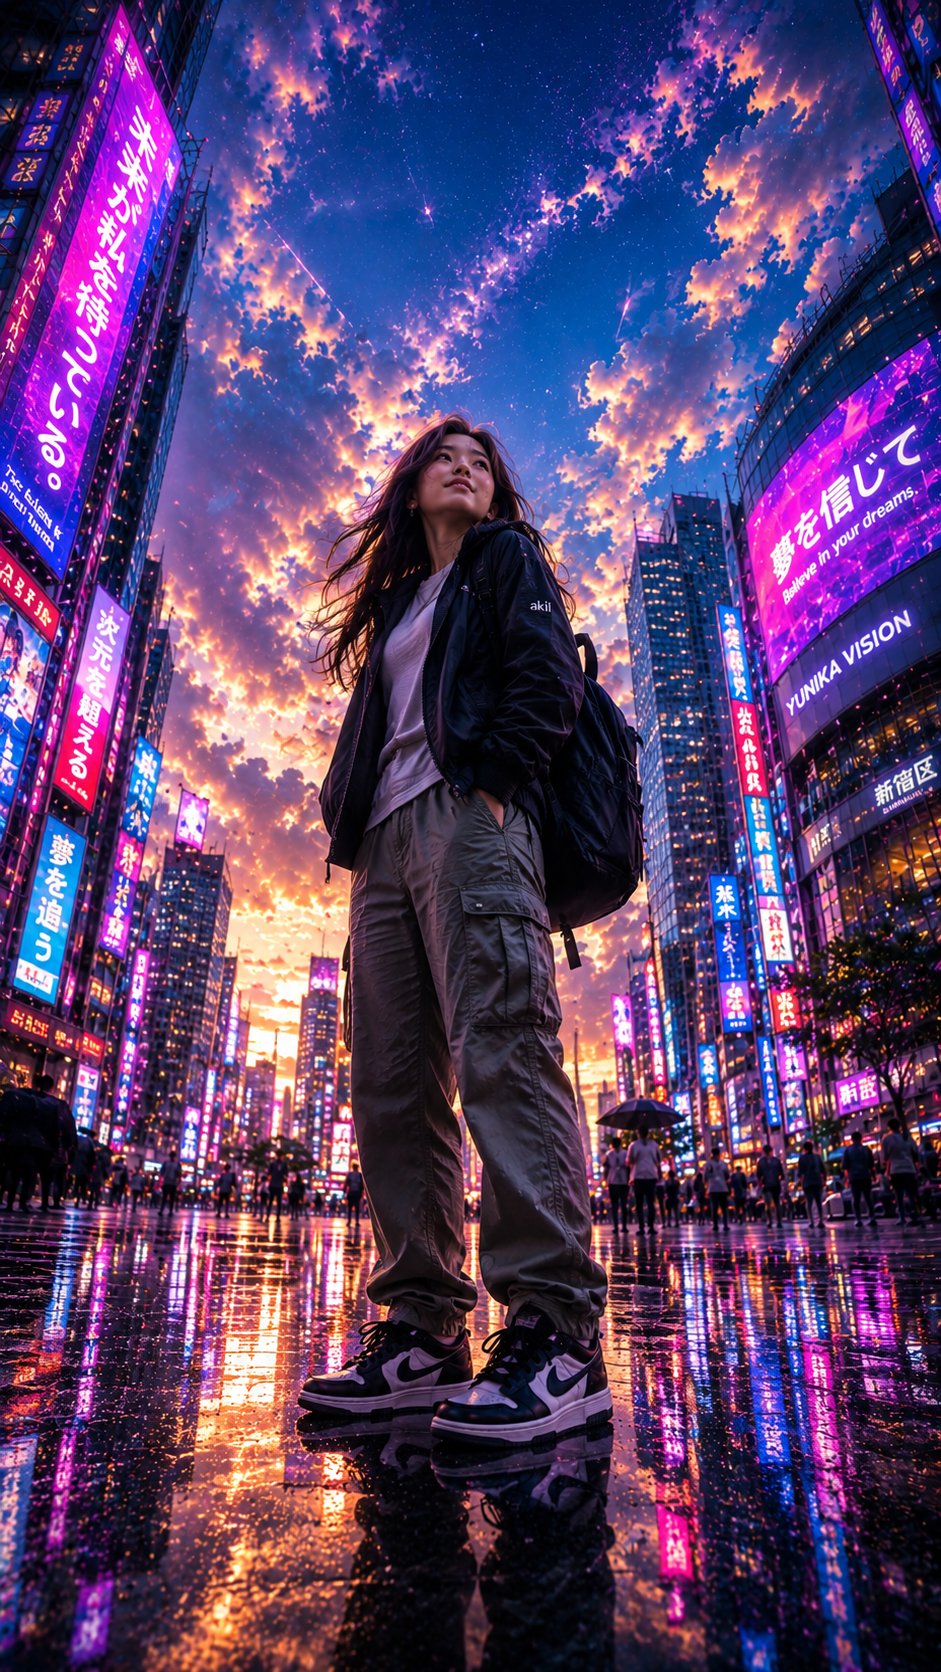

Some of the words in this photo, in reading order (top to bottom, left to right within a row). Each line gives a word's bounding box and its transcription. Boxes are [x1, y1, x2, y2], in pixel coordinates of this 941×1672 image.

[770, 424, 921, 585] 夢を信じて
[817, 549, 831, 566] in
[832, 523, 860, 557] your
[862, 485, 919, 529] dreams.
[530, 600, 552, 613] akil
[785, 659, 842, 717] YUNIKA
[842, 609, 912, 667] VISION
[35, 834, 76, 963] 夢を追う
